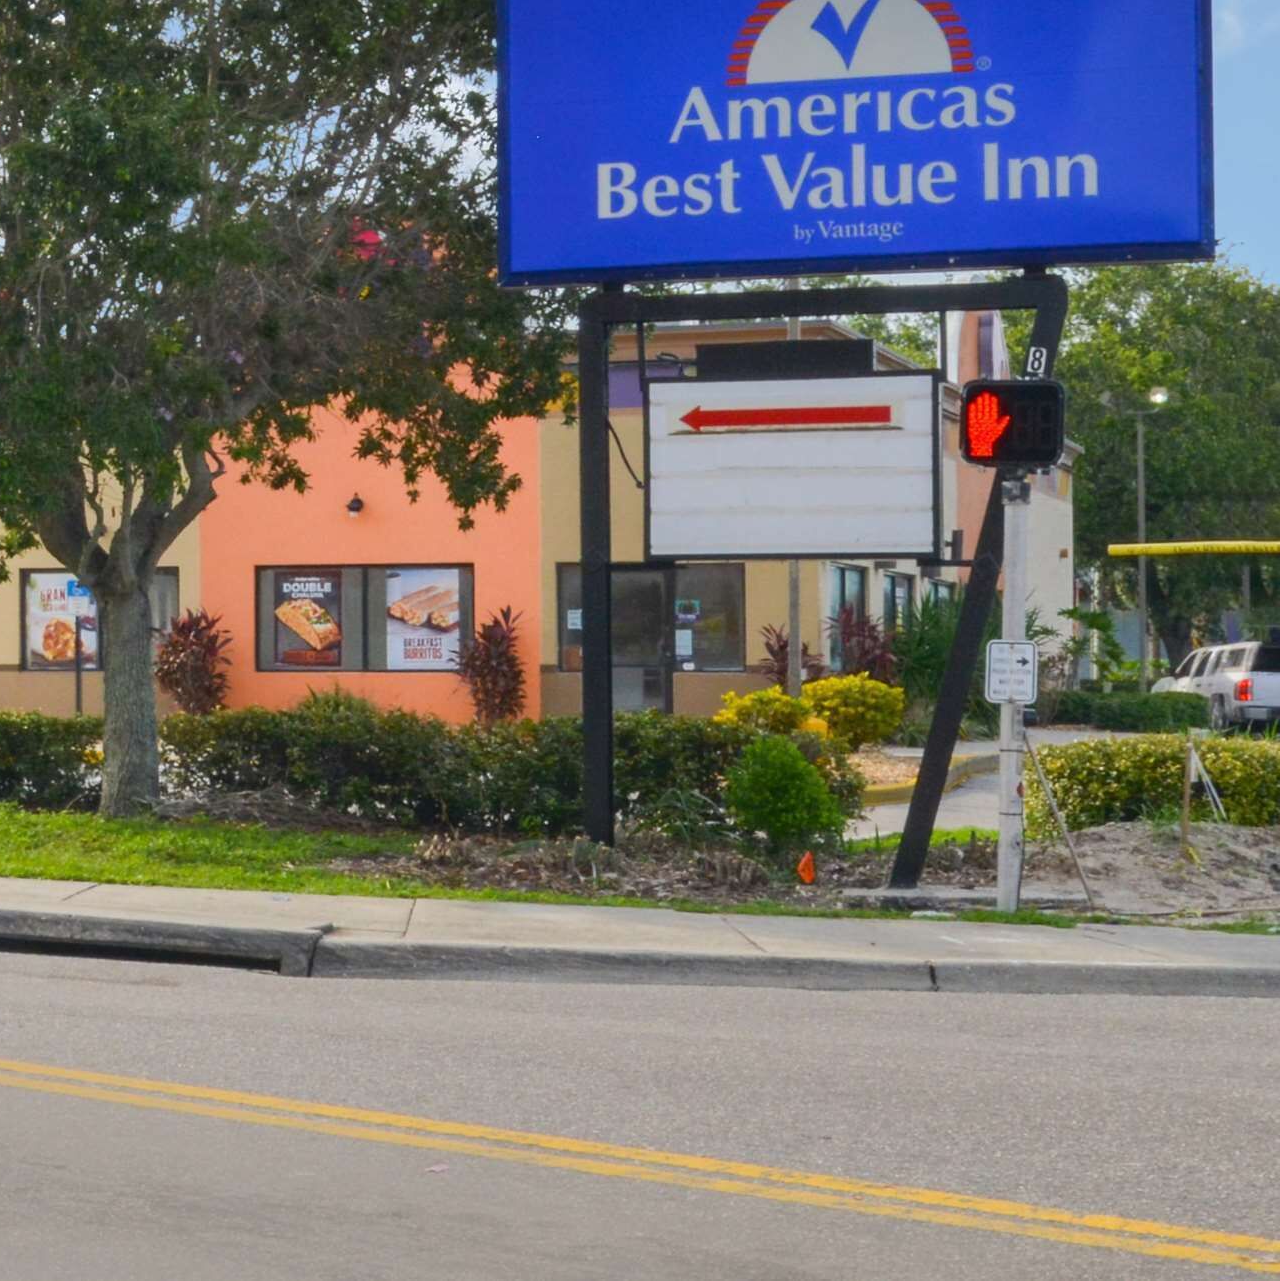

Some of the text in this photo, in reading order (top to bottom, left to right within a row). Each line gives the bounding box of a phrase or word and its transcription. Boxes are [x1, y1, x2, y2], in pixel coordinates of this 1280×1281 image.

[668, 80, 1017, 144] Americas
[596, 141, 1100, 220] Best Value Inn
[792, 219, 905, 245] by Vantage
[1031, 348, 1044, 372] 8
[40, 587, 66, 602] GRAN
[282, 581, 333, 594] DOUBLE
